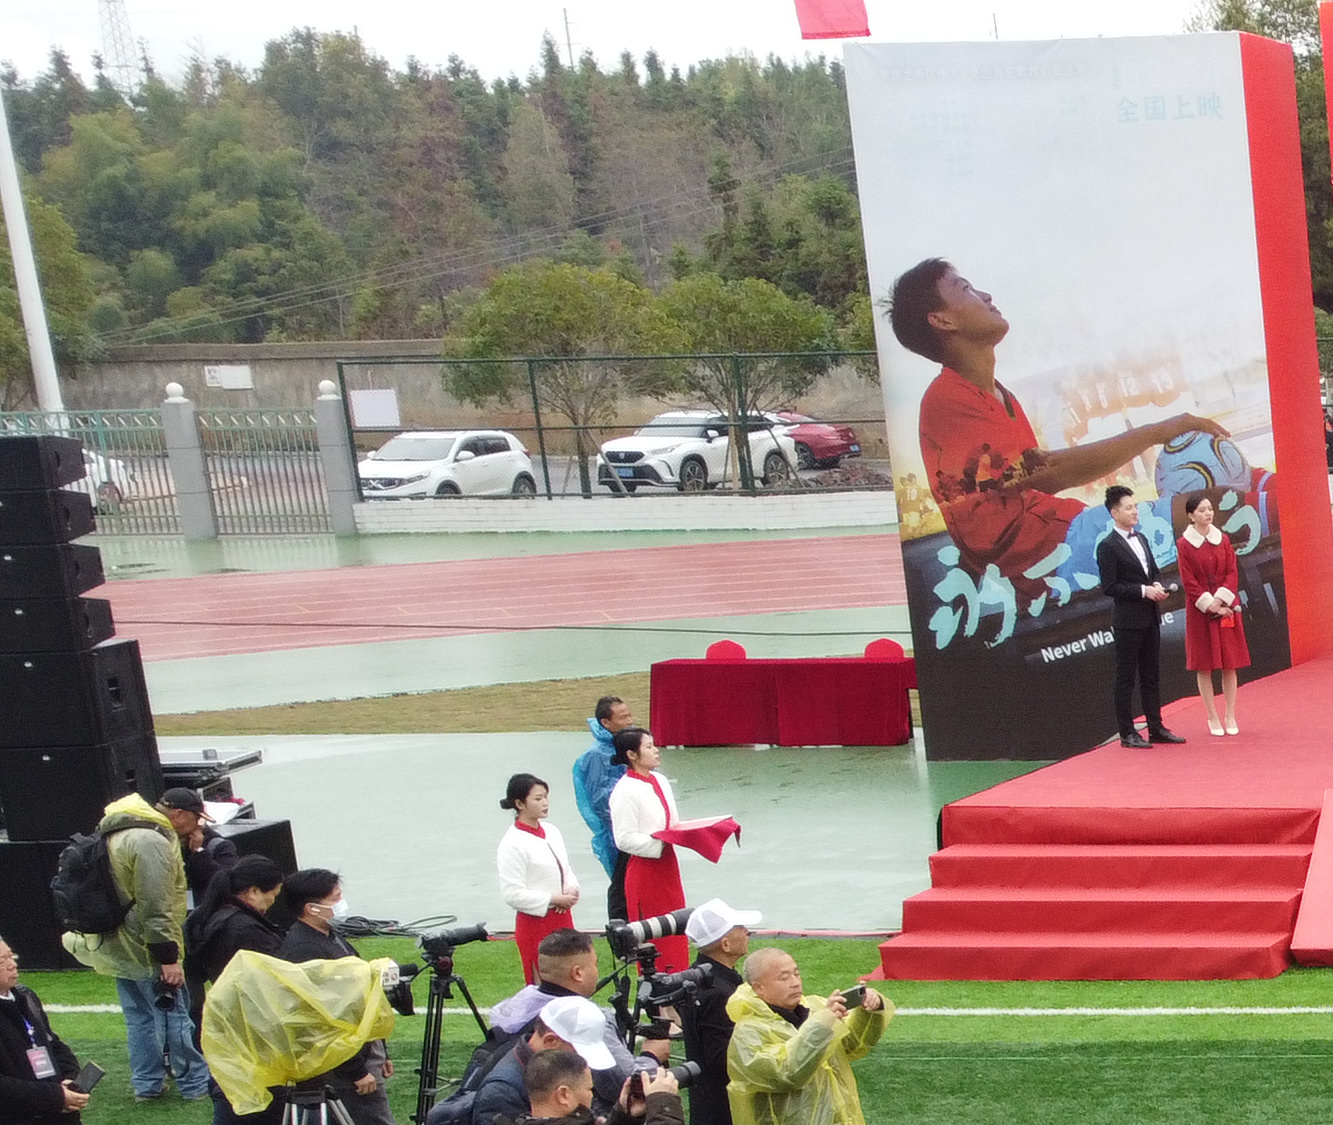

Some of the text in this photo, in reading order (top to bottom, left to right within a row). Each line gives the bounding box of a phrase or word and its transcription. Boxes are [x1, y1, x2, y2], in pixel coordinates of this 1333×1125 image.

[1116, 93, 1224, 123] 全国上映
[1041, 637, 1087, 664] Never
